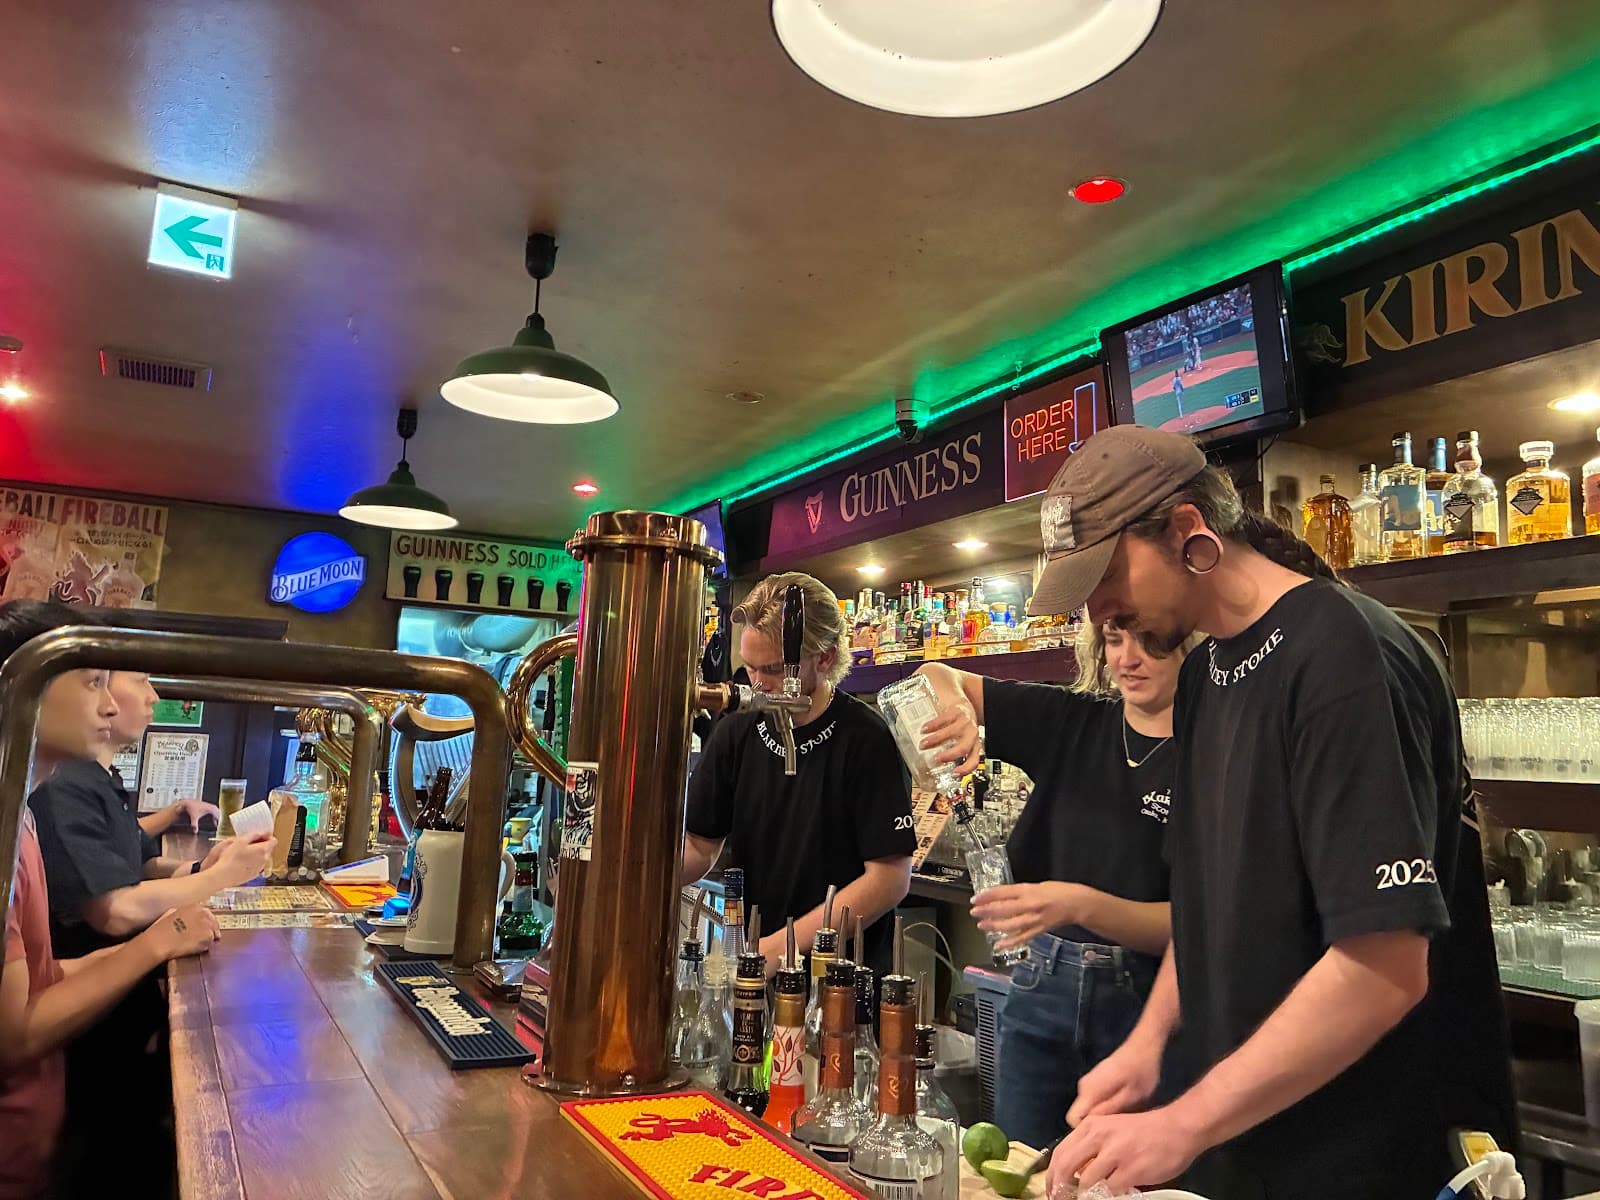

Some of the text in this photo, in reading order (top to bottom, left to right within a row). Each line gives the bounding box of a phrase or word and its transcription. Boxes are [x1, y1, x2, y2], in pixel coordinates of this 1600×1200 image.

[1340, 209, 1600, 368] KIRIN
[1010, 399, 1075, 439] ORDER
[1018, 427, 1067, 463] HERE
[840, 432, 982, 522] GUINNESS
[0, 488, 59, 524] BALL
[61, 498, 165, 537] FIREBALL
[396, 534, 499, 565] GUINNESS
[507, 548, 547, 570] SOLD
[272, 560, 361, 602] BLUE MOON
[756, 720, 797, 758] BLARNE
[1375, 858, 1437, 890] 2025
